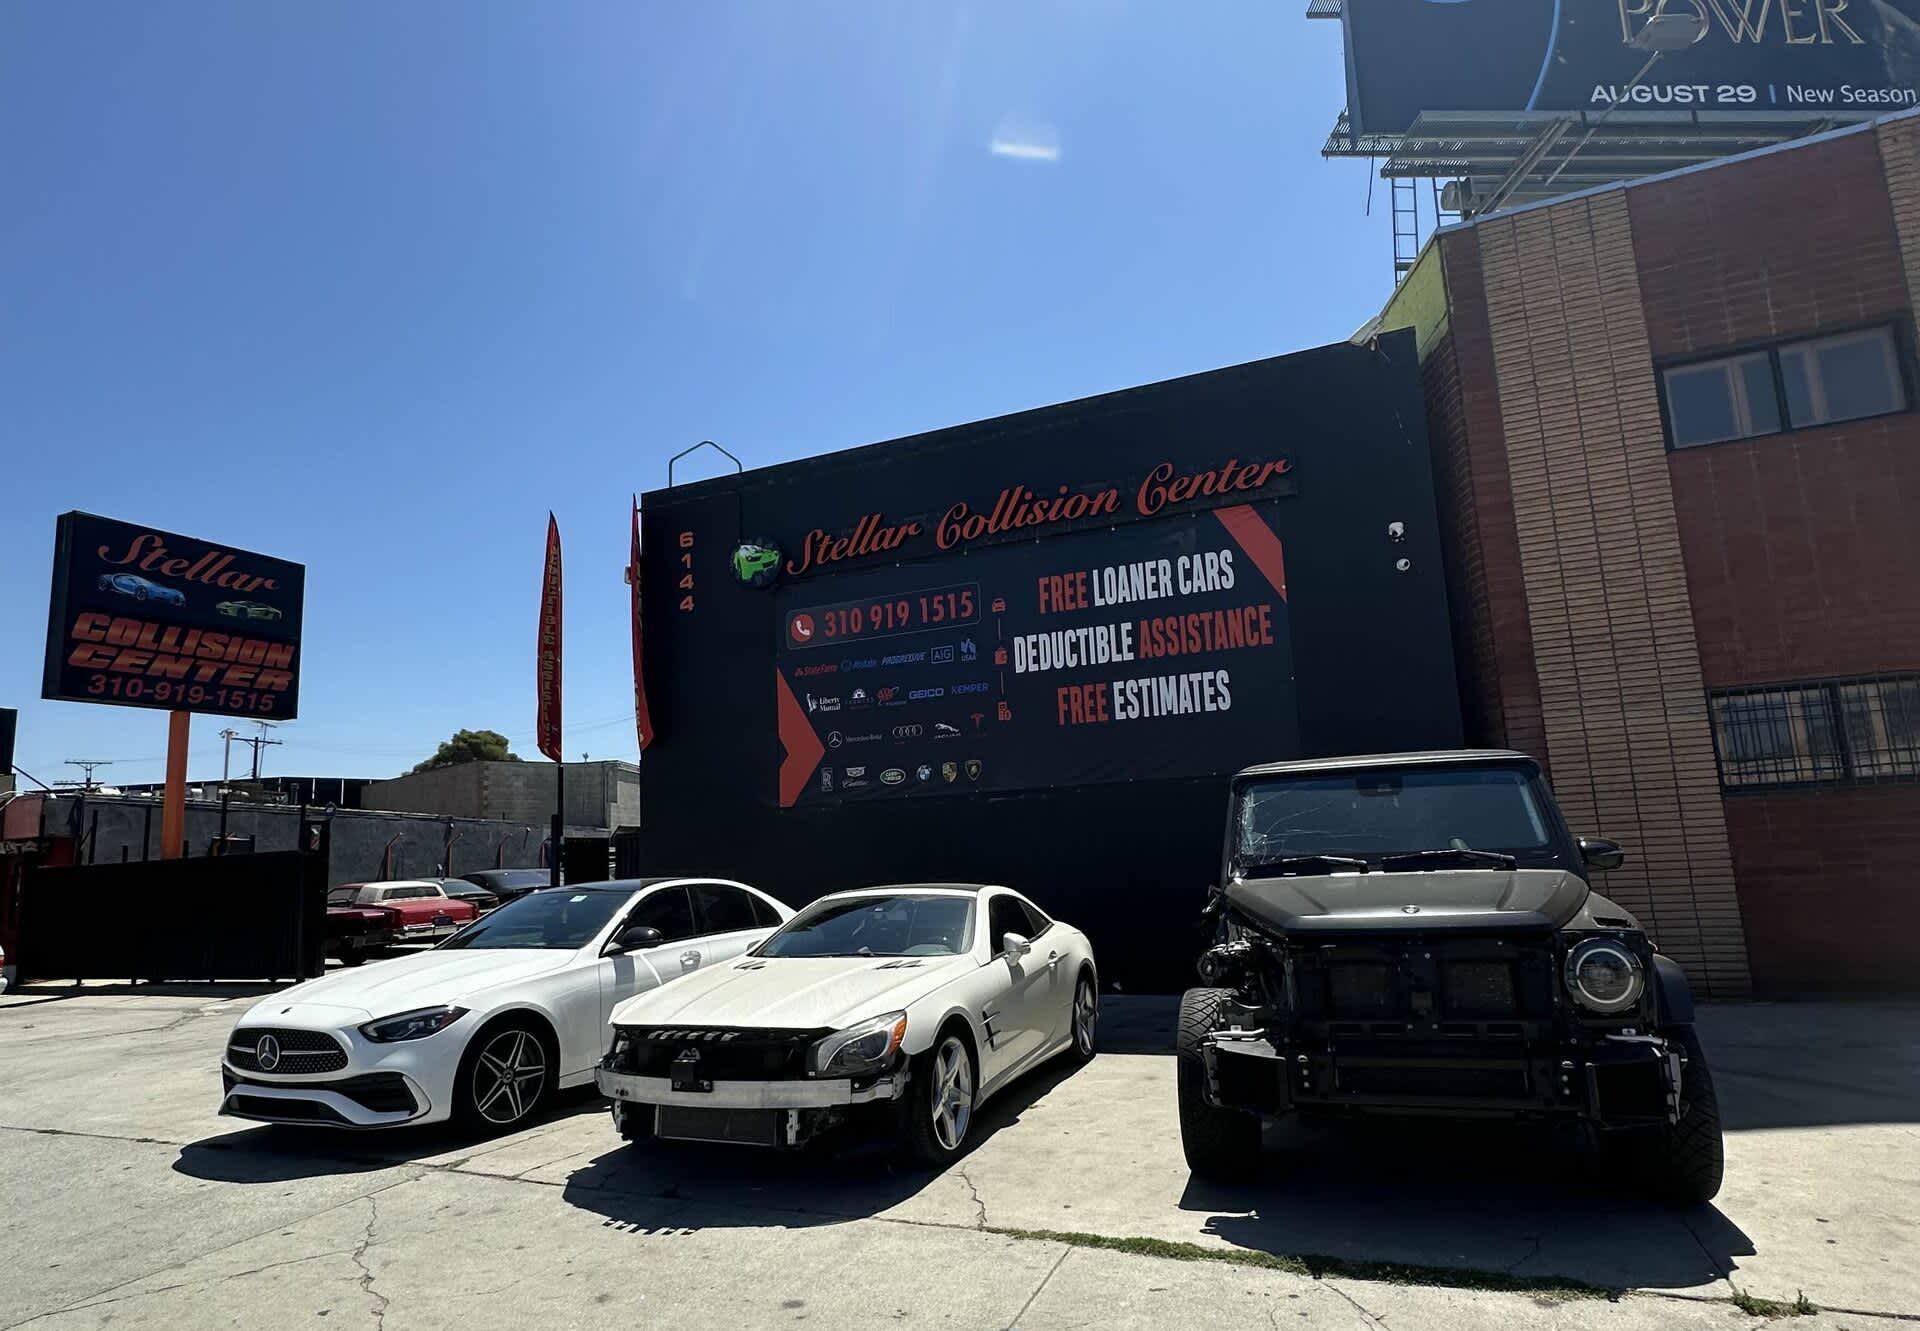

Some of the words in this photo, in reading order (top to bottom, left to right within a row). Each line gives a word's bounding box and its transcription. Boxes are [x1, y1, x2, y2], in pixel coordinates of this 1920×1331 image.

[1590, 85, 1709, 103] AUGUST
[1716, 85, 1757, 103] 29
[1787, 86, 1834, 103] New
[1841, 85, 1917, 103] Season
[787, 513, 921, 575] Stellar
[936, 485, 1120, 549] Collision
[1136, 458, 1293, 516] Center
[98, 534, 279, 592] Stellar
[679, 531, 695, 611] 6144
[1038, 571, 1089, 614] FREE
[1092, 558, 1174, 607] LOANER
[1177, 549, 1235, 595] CARS
[71, 612, 295, 669] COLLISION
[825, 608, 863, 637] 310
[869, 600, 910, 631] 919
[919, 591, 974, 624] 1515
[1013, 621, 1135, 674] DEDUCTIBLE
[1138, 603, 1274, 660] ASSISTANCE
[67, 643, 294, 692] CENTER
[934, 648, 952, 661] AIG
[87, 674, 276, 713] 310-919-1515
[909, 688, 944, 700] GEICO
[951, 682, 989, 695] KEMPER
[1057, 682, 1110, 726] FREE
[1112, 669, 1232, 721] ESTIMATES
